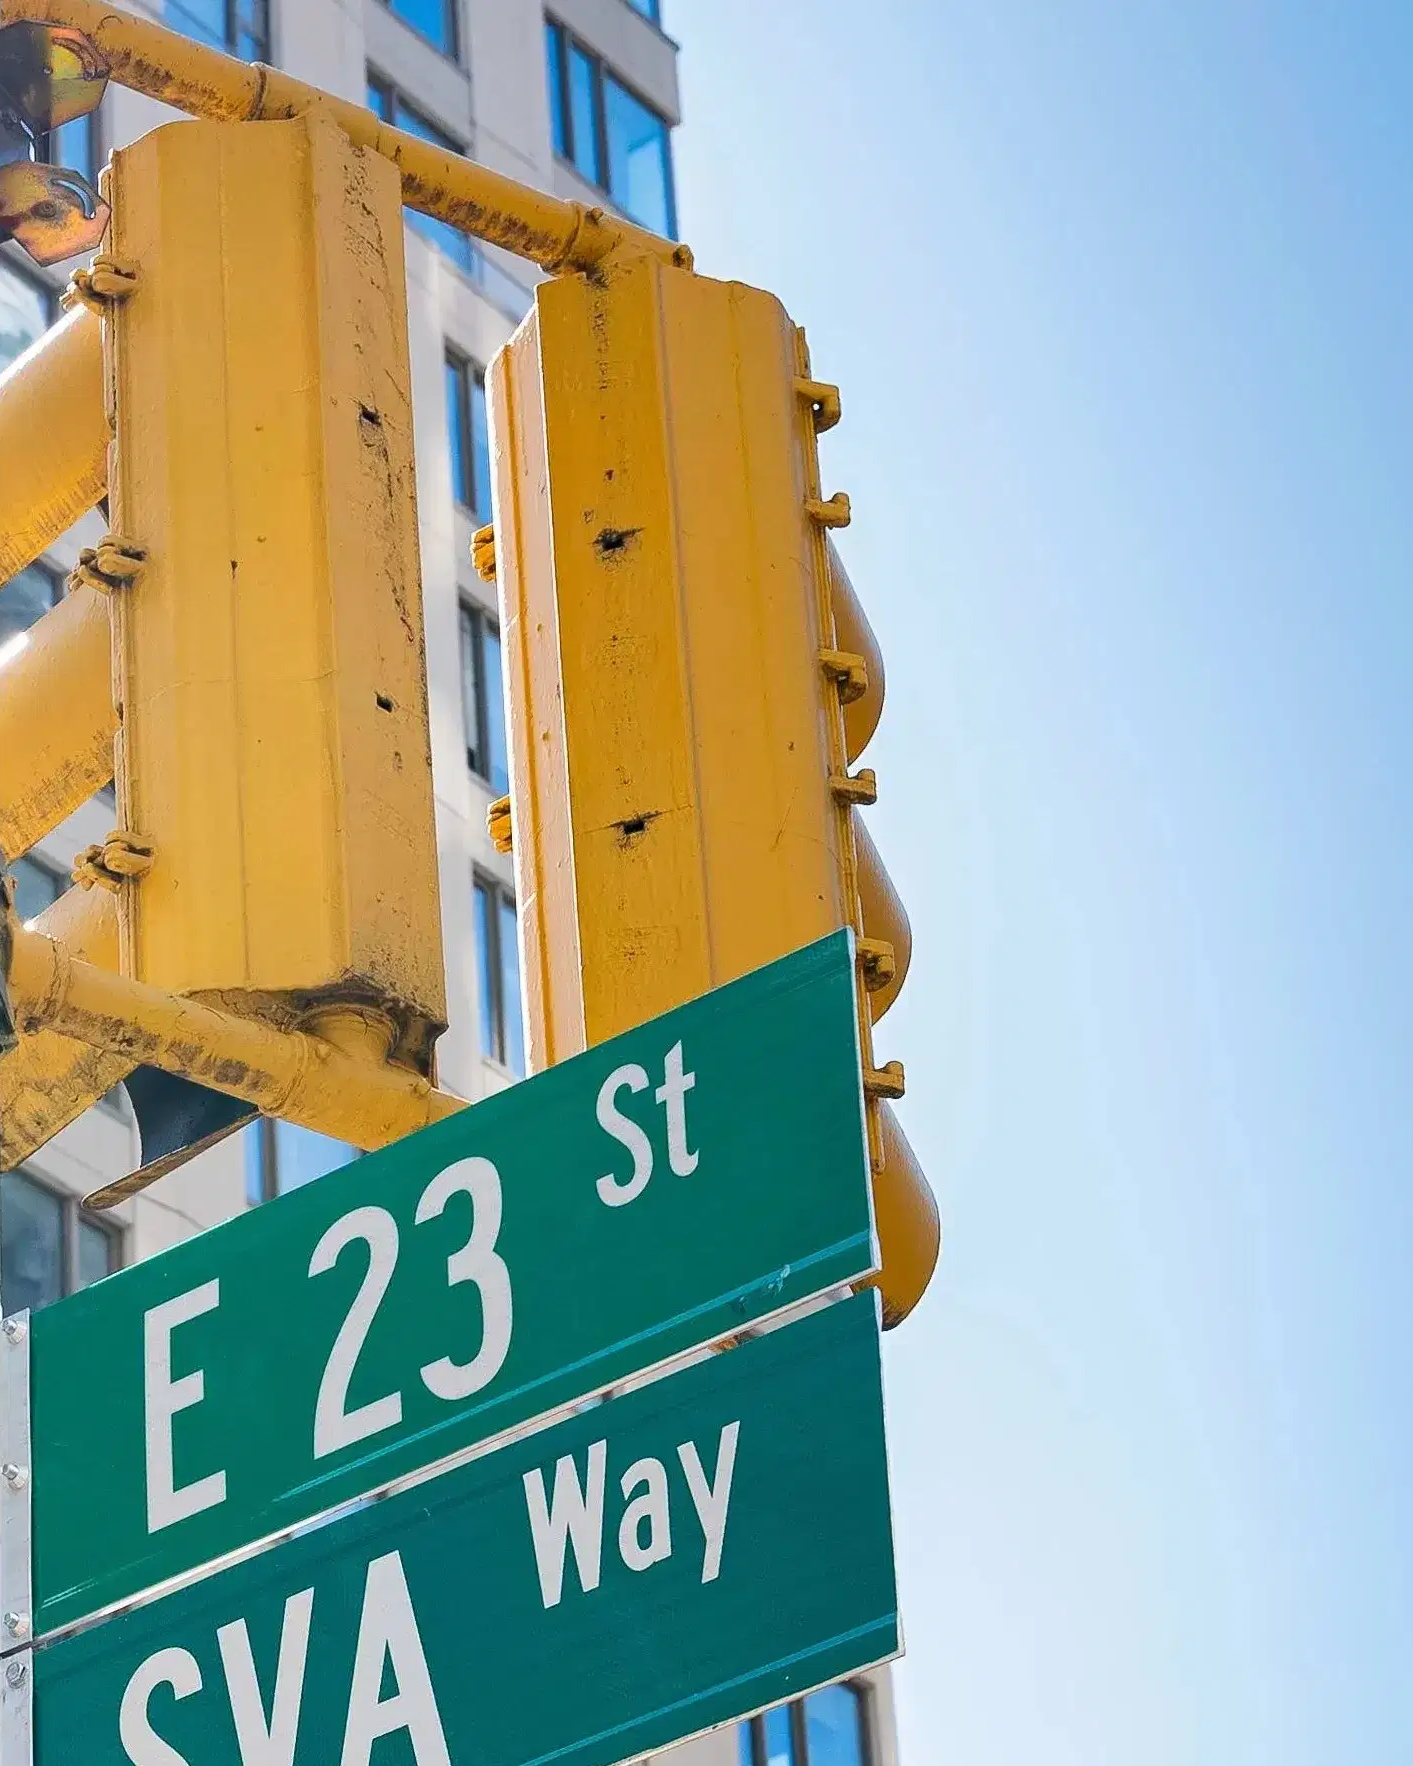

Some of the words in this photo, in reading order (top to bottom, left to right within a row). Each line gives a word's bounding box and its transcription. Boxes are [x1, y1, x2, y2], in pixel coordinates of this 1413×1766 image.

[144, 1278, 227, 1533] E
[308, 1156, 514, 1459] 23
[595, 1040, 699, 1207] St
[522, 1420, 740, 1609] Way
